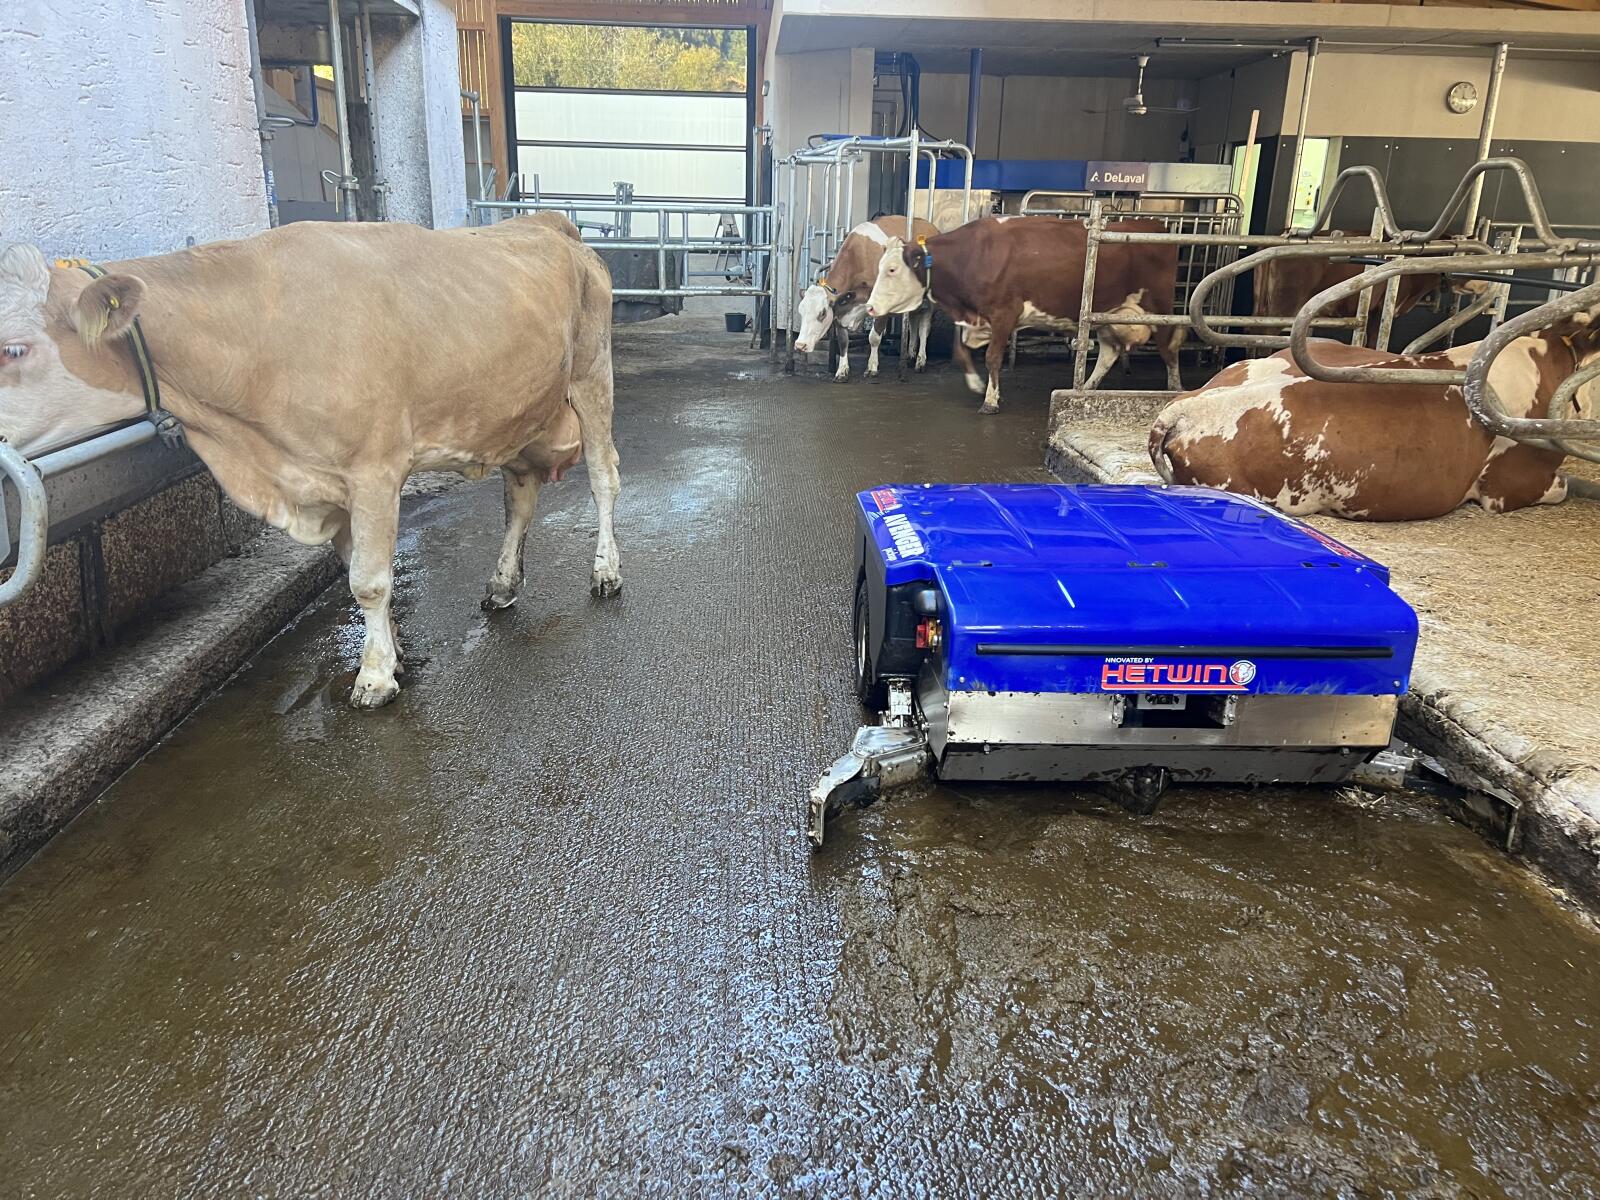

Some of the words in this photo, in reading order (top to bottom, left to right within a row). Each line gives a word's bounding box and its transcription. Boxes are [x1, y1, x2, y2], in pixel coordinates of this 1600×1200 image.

[1104, 172, 1145, 184] DeLaval
[883, 513, 925, 558] AVENGER
[1101, 664, 1228, 683] HETWIN
